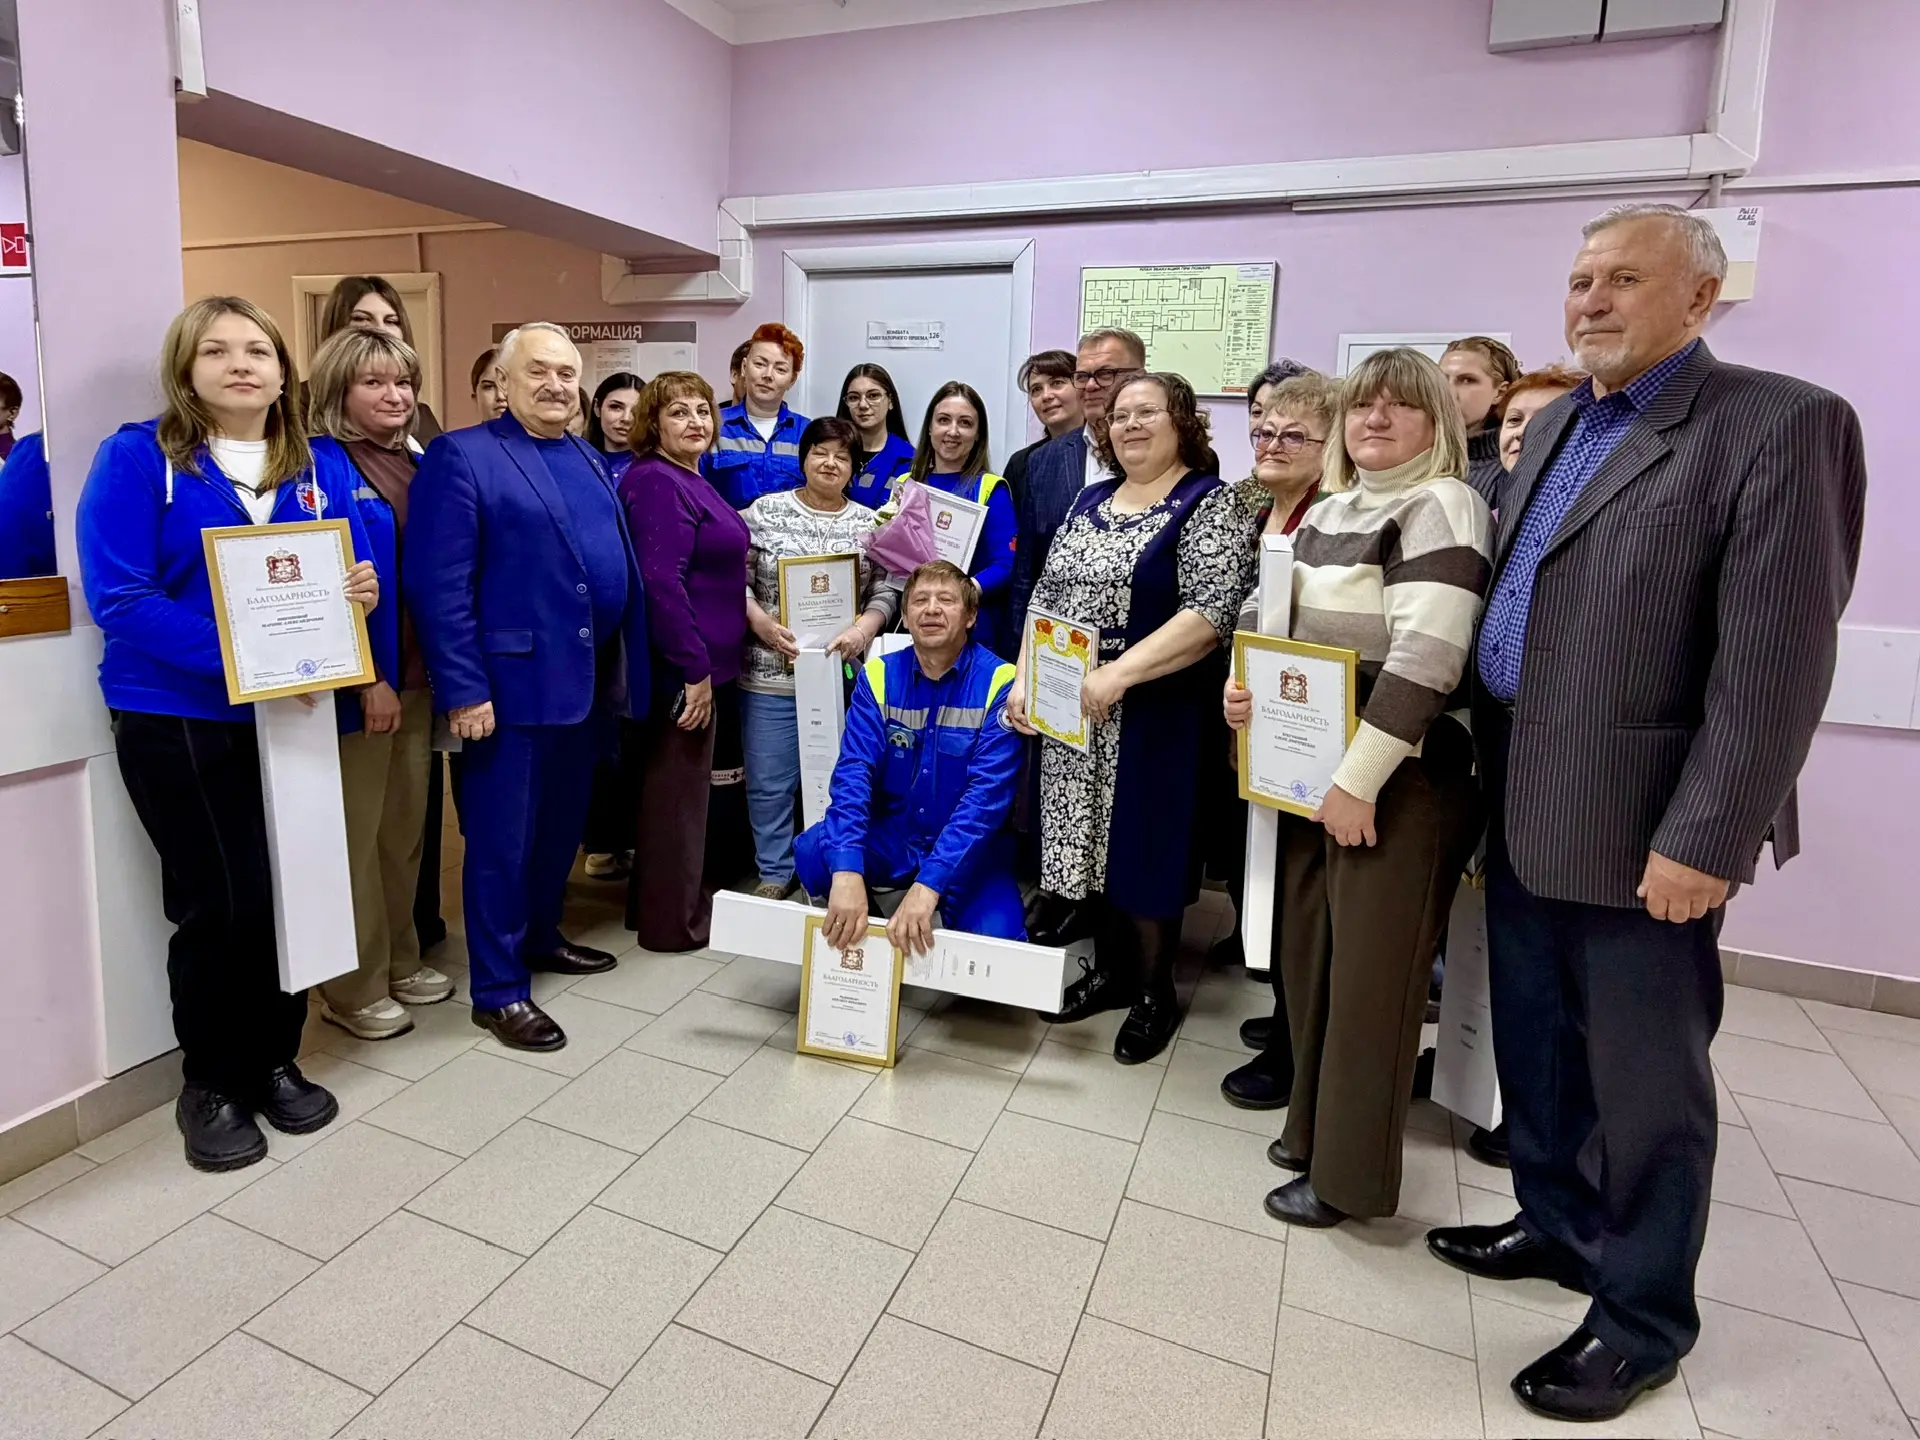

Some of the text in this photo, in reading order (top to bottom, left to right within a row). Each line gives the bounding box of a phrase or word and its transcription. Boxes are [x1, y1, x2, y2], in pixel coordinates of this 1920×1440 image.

[563, 325, 642, 340] ОРМАЦИЯ
[246, 589, 330, 605] БЛАГОДАРНОСТЬ
[1261, 705, 1329, 726] БЛАГОДАРНОСТЬ
[823, 973, 879, 988] БЛАГОДАРНОСТЬ
